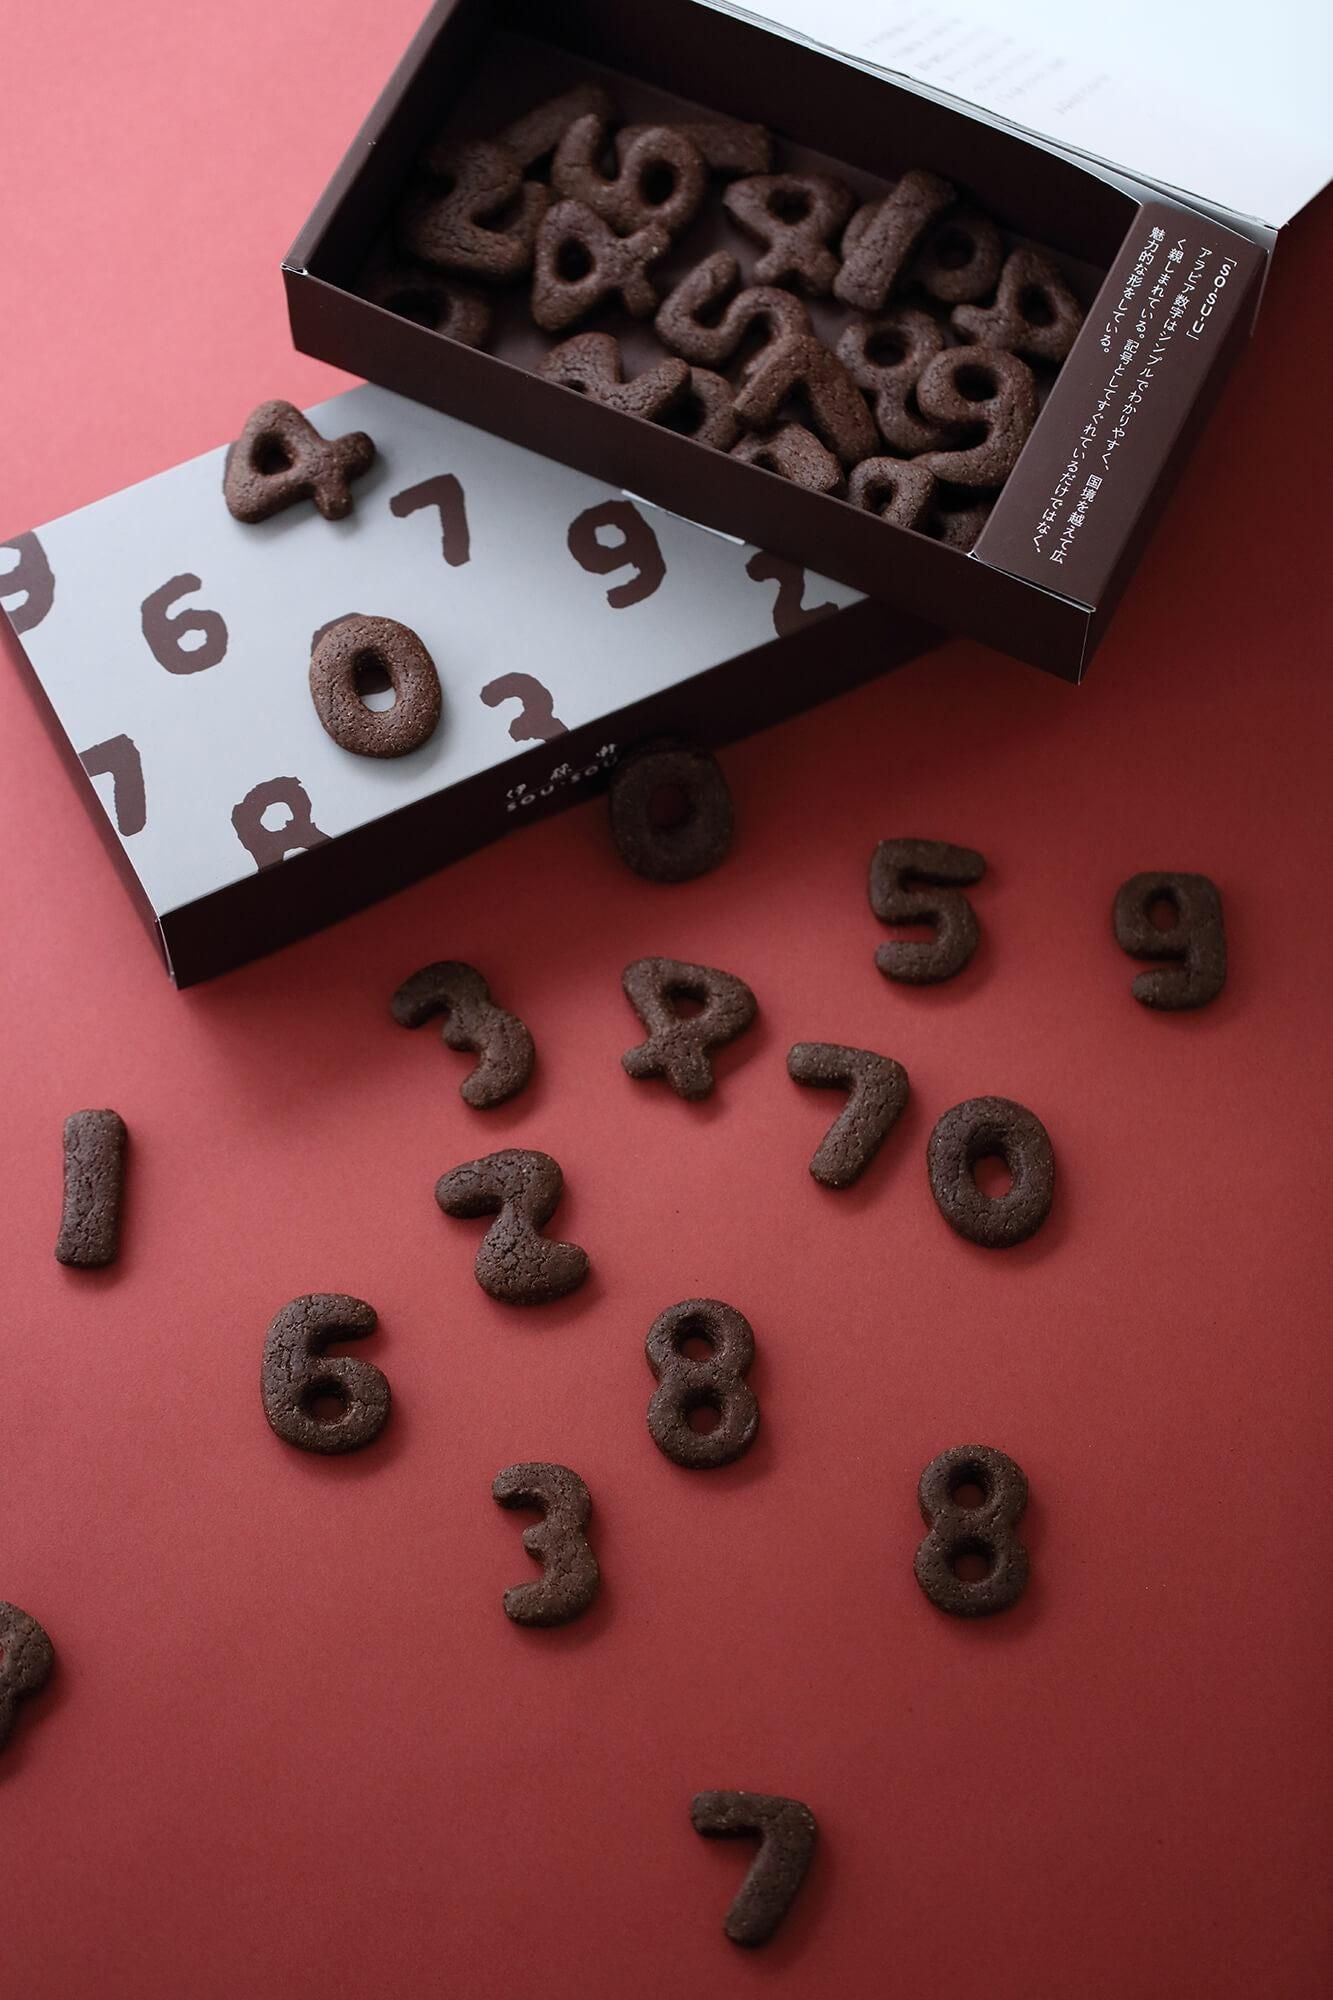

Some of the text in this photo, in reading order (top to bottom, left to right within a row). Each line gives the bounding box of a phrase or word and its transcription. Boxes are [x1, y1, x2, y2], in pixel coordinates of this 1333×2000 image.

[1099, 226, 1166, 355] 魅力的な形をしている。
[222, 399, 377, 524] 4
[389, 473, 471, 567] 7
[141, 572, 229, 674] 6
[567, 499, 668, 609] 9
[309, 614, 442, 758] 0
[79, 733, 147, 836] 7
[868, 837, 988, 985] 5
[1113, 870, 1227, 1011] 9
[390, 959, 536, 1109] 3
[621, 956, 759, 1102] 4
[786, 1042, 910, 1189] 7
[926, 1096, 1055, 1248] 0
[434, 1148, 590, 1304] 2
[260, 1293, 391, 1454] 6
[645, 1298, 760, 1470] 8
[492, 1462, 598, 1627] 3
[913, 1444, 1030, 1619] 8
[690, 1790, 818, 1949] 7
